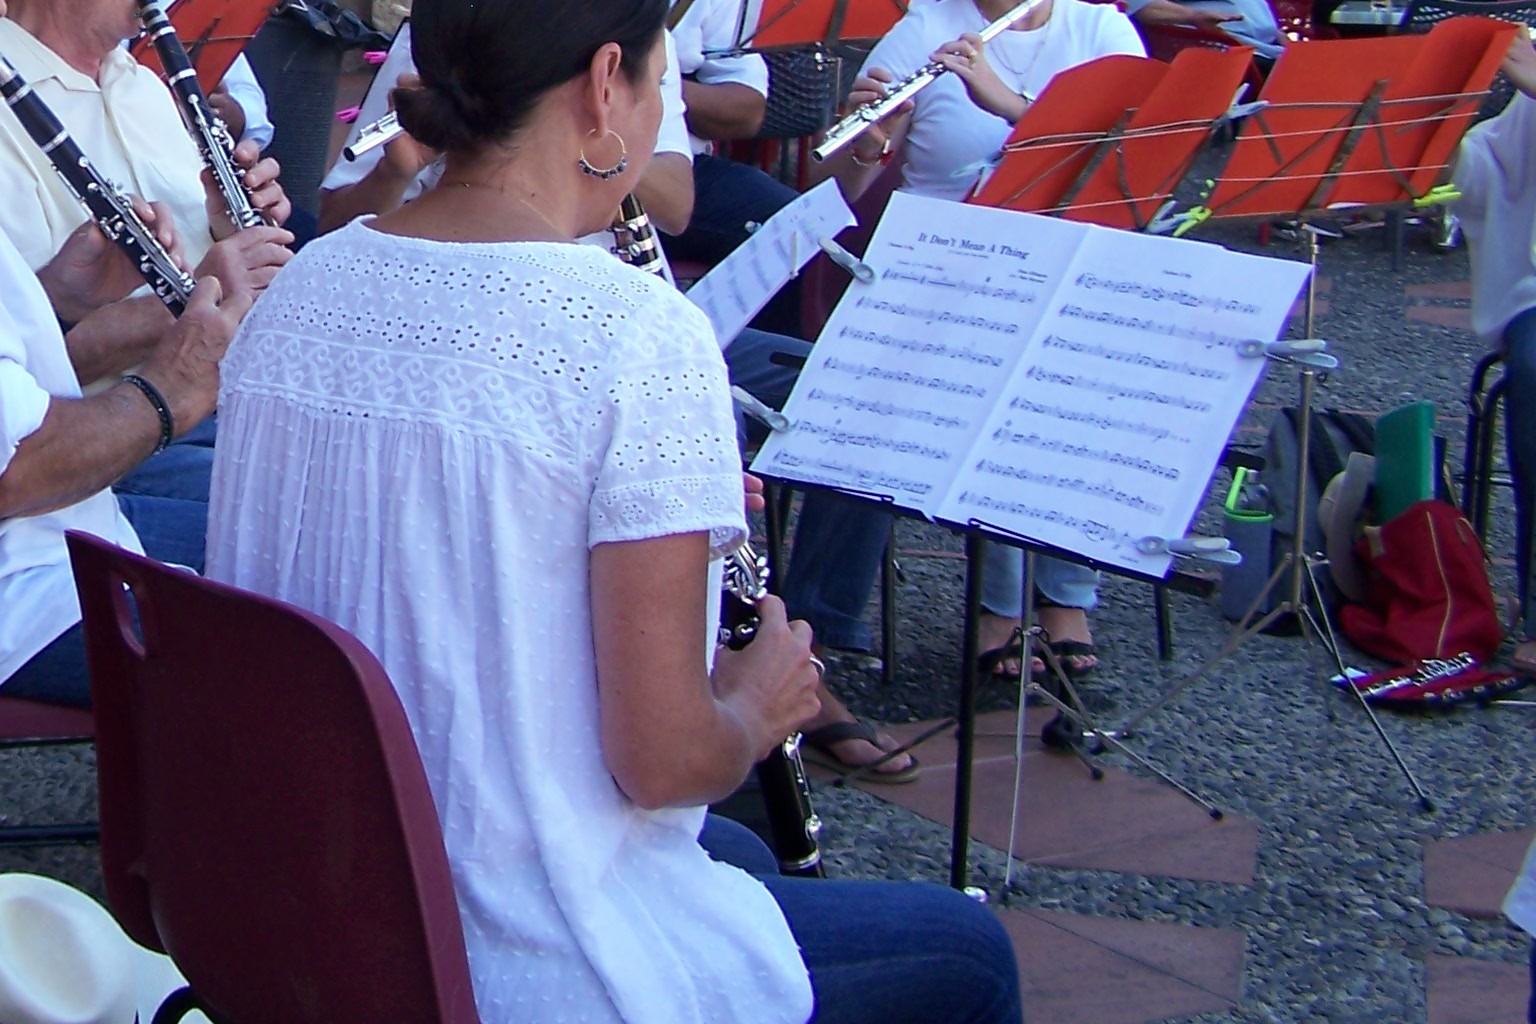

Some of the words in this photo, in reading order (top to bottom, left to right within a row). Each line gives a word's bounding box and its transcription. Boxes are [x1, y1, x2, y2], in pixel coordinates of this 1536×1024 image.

[917, 231, 928, 243] It
[929, 233, 957, 248] Don't
[958, 238, 986, 252] Mean
[988, 243, 997, 254] A
[999, 244, 1030, 261] Thing
